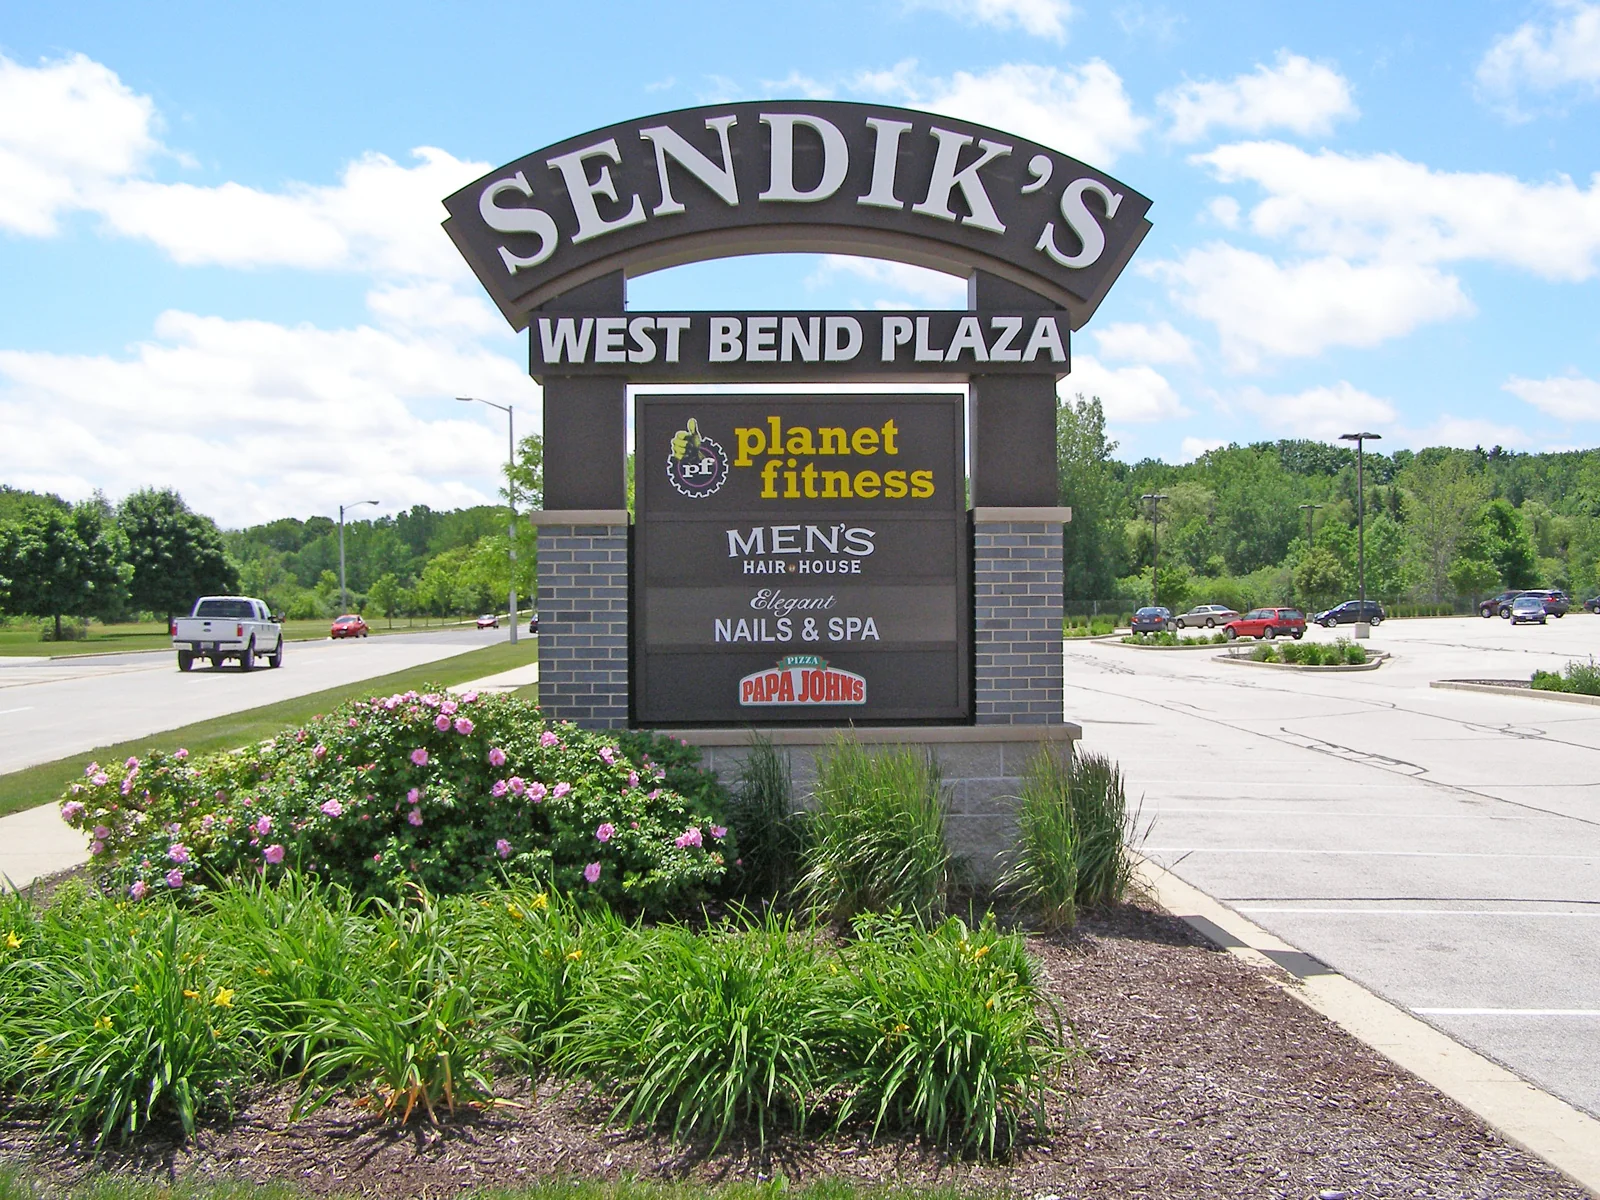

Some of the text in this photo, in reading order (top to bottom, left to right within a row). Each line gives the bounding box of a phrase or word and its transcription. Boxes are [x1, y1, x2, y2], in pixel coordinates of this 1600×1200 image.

[478, 112, 1124, 275] SENDIK'S
[538, 316, 1067, 364] WEST BEND PLAZA
[734, 416, 898, 466] planet
[760, 459, 935, 499] fitness
[726, 523, 876, 558] MEN'S
[743, 560, 861, 574] HAIR HOUSE
[749, 588, 837, 617] Elegant
[715, 617, 880, 642] NAILS & SPA
[786, 655, 820, 666] PIZZA
[742, 671, 796, 702] PAPA
